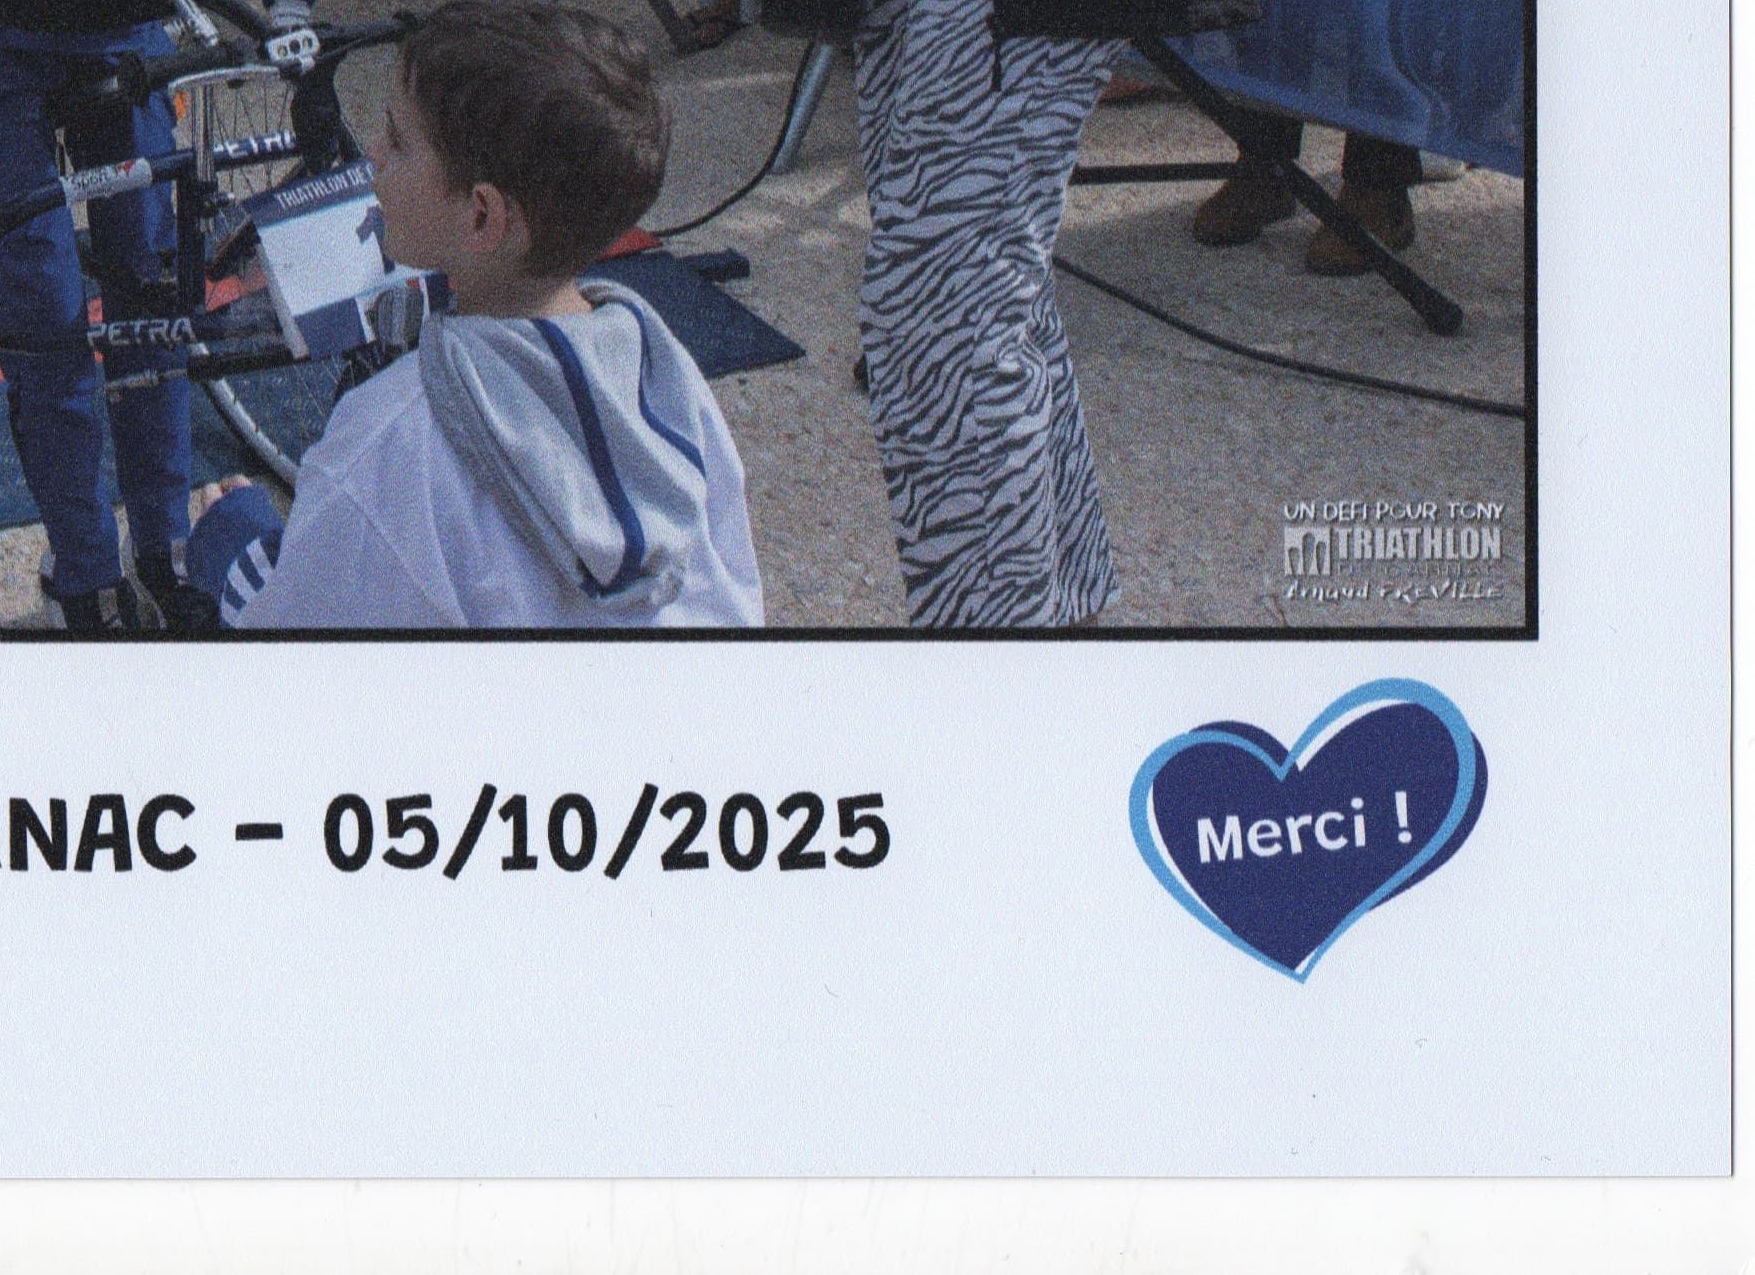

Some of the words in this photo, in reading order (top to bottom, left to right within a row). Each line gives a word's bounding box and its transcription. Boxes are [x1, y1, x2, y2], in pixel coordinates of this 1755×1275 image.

[274, 172, 348, 210] TRIATHLON
[346, 165, 367, 185] DE
[86, 316, 198, 347] PETRA
